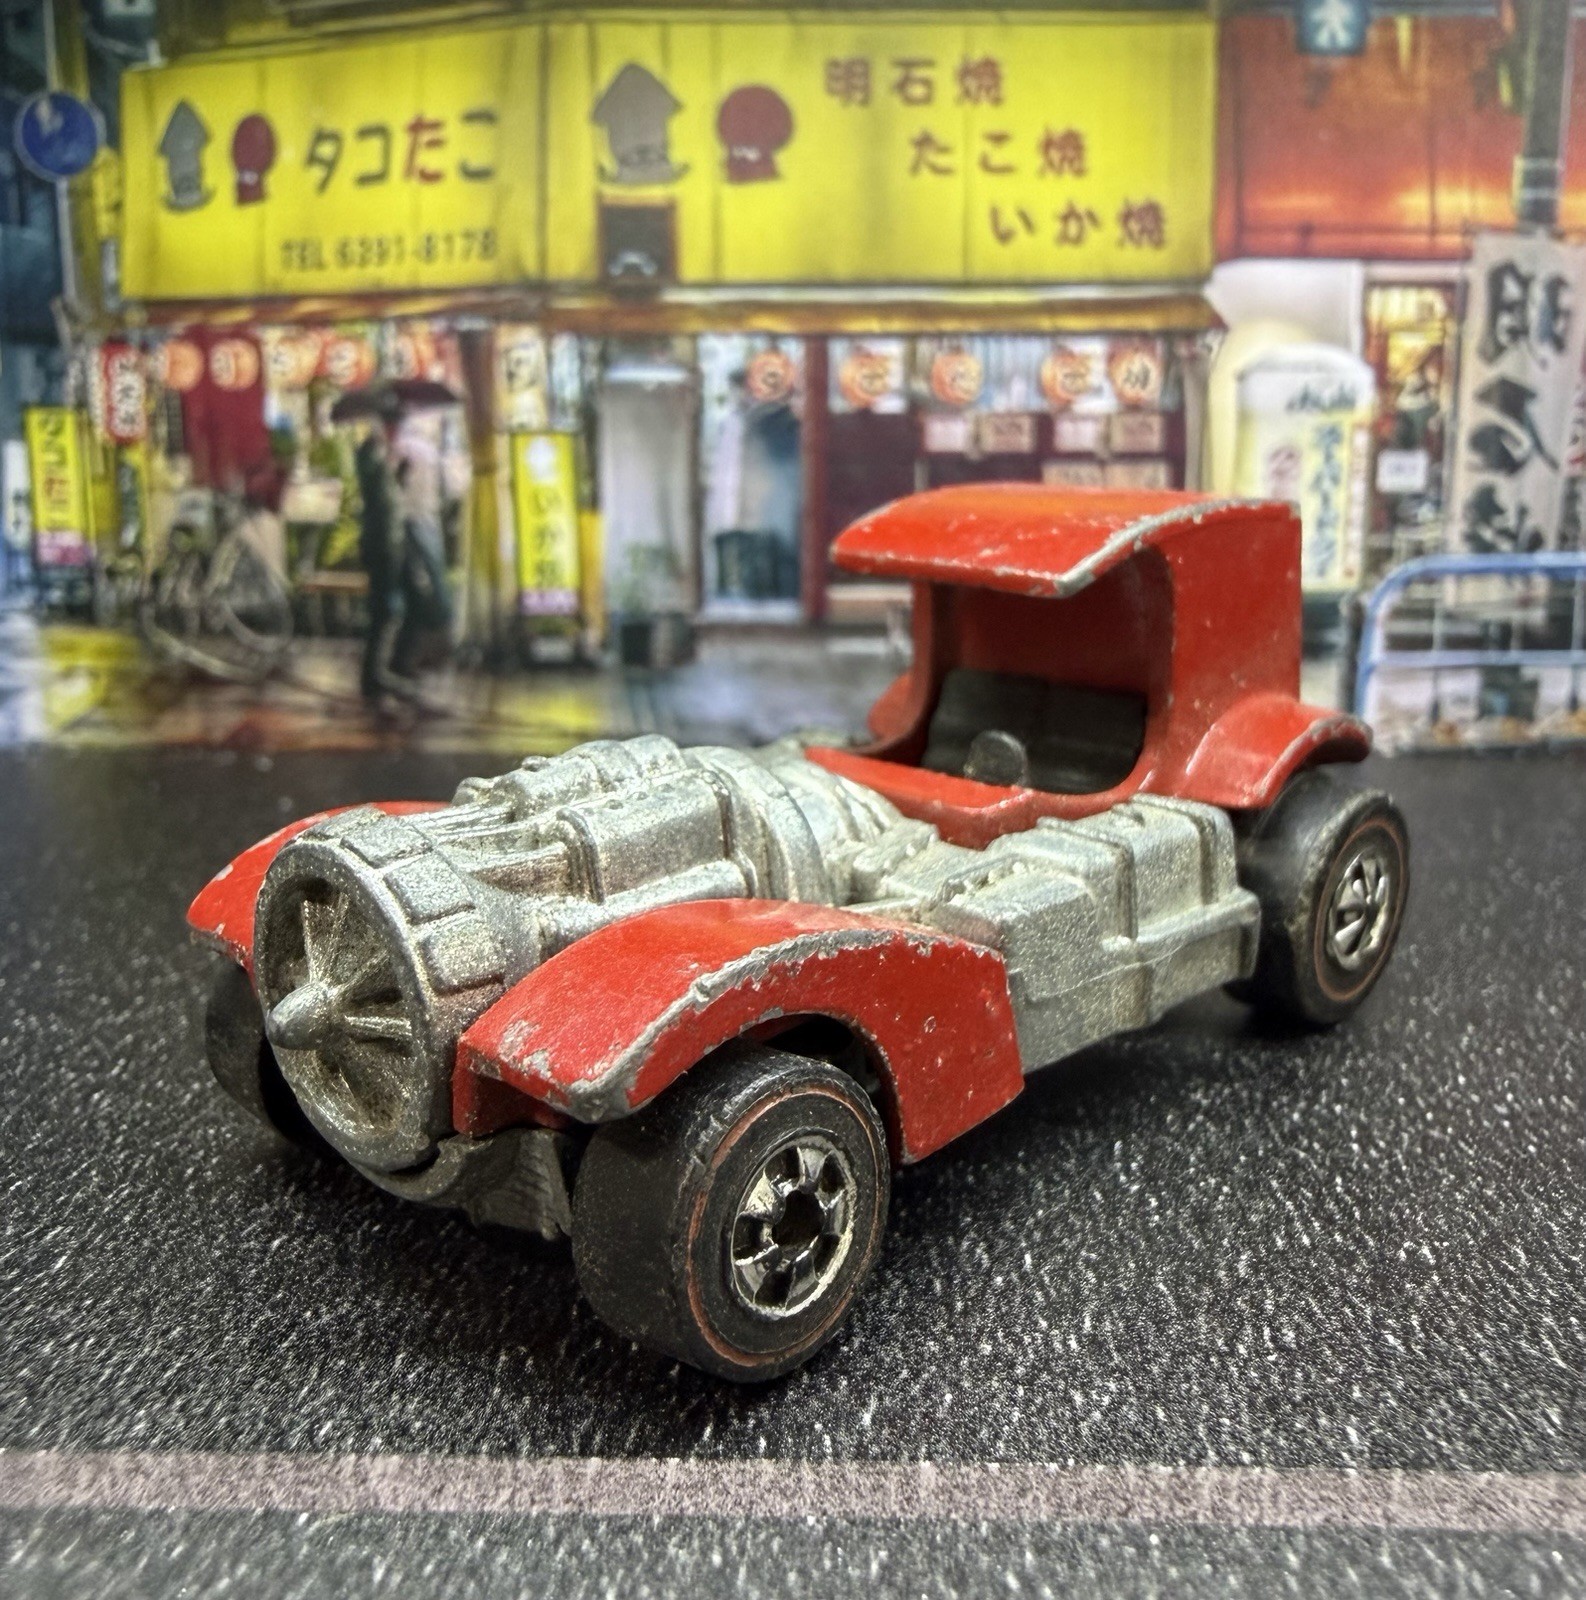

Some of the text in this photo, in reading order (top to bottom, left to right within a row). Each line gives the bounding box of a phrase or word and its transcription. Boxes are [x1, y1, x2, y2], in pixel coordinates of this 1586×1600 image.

[825, 57, 1005, 107] 明石焼
[306, 108, 498, 194] タコたこ
[909, 127, 1088, 178] たこ焼
[989, 197, 1166, 249] いか焼
[281, 238, 326, 270] TEL
